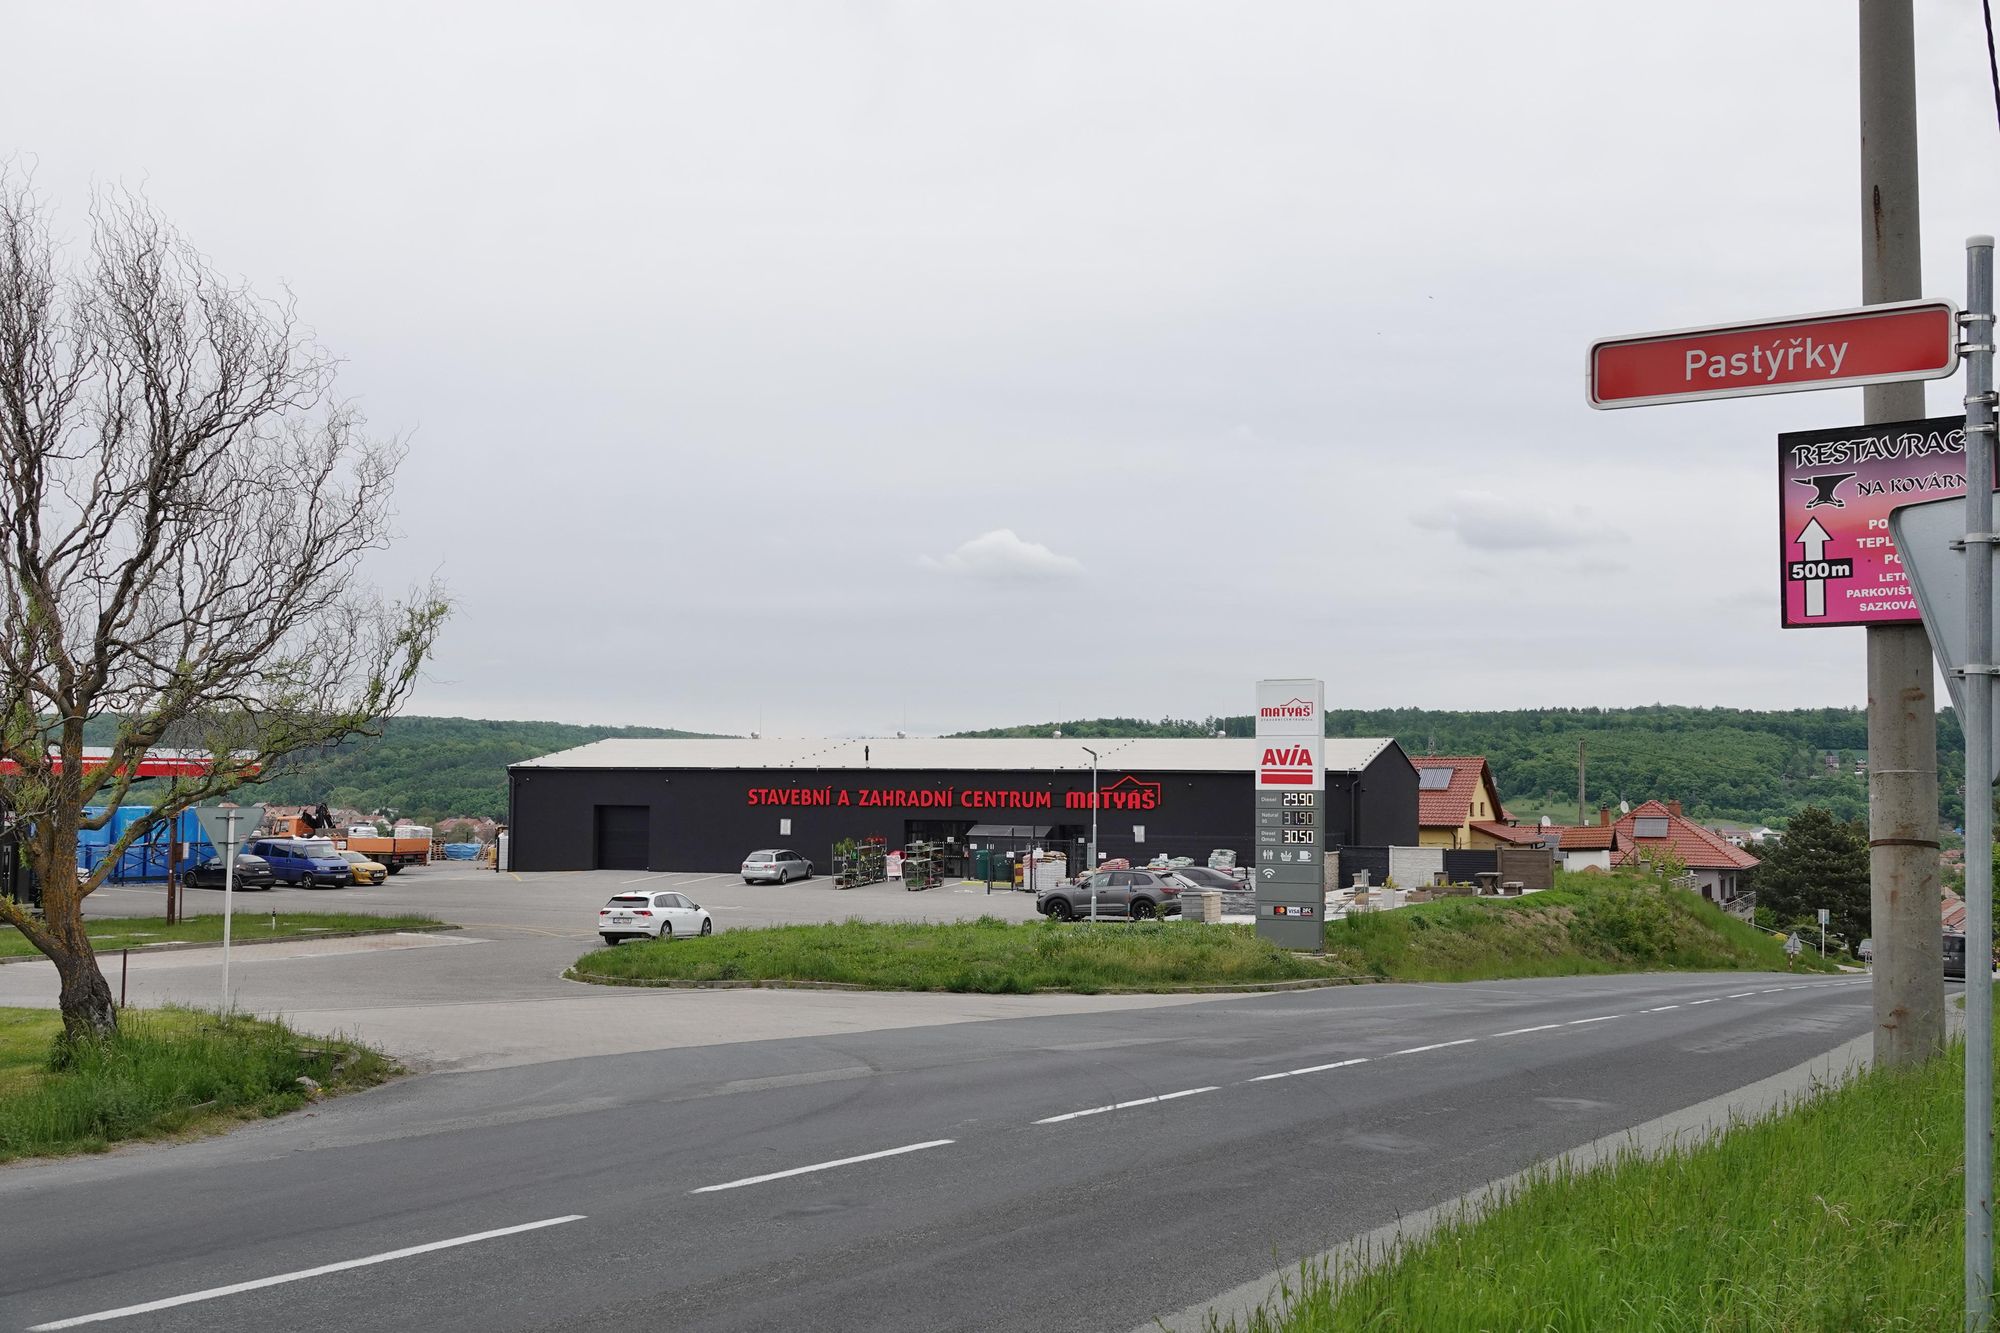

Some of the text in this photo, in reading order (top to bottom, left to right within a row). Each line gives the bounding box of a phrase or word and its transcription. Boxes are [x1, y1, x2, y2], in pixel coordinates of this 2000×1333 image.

[1685, 337, 1848, 381] Pastýřky
[1791, 429, 1966, 469] RESTAURAC
[1856, 479, 1886, 498] NA
[1856, 536, 1895, 548] TEPL
[1859, 600, 1917, 612] SAZKOVÁ
[748, 785, 1051, 808] STAVEBNÍ A ZAHRADNÍ CENTRUM
[1066, 789, 1155, 810] MATYÁŠ
[1283, 793, 1314, 806] 29.90
[1284, 812, 1314, 825] 31.90
[1284, 830, 1314, 844] 30.50
